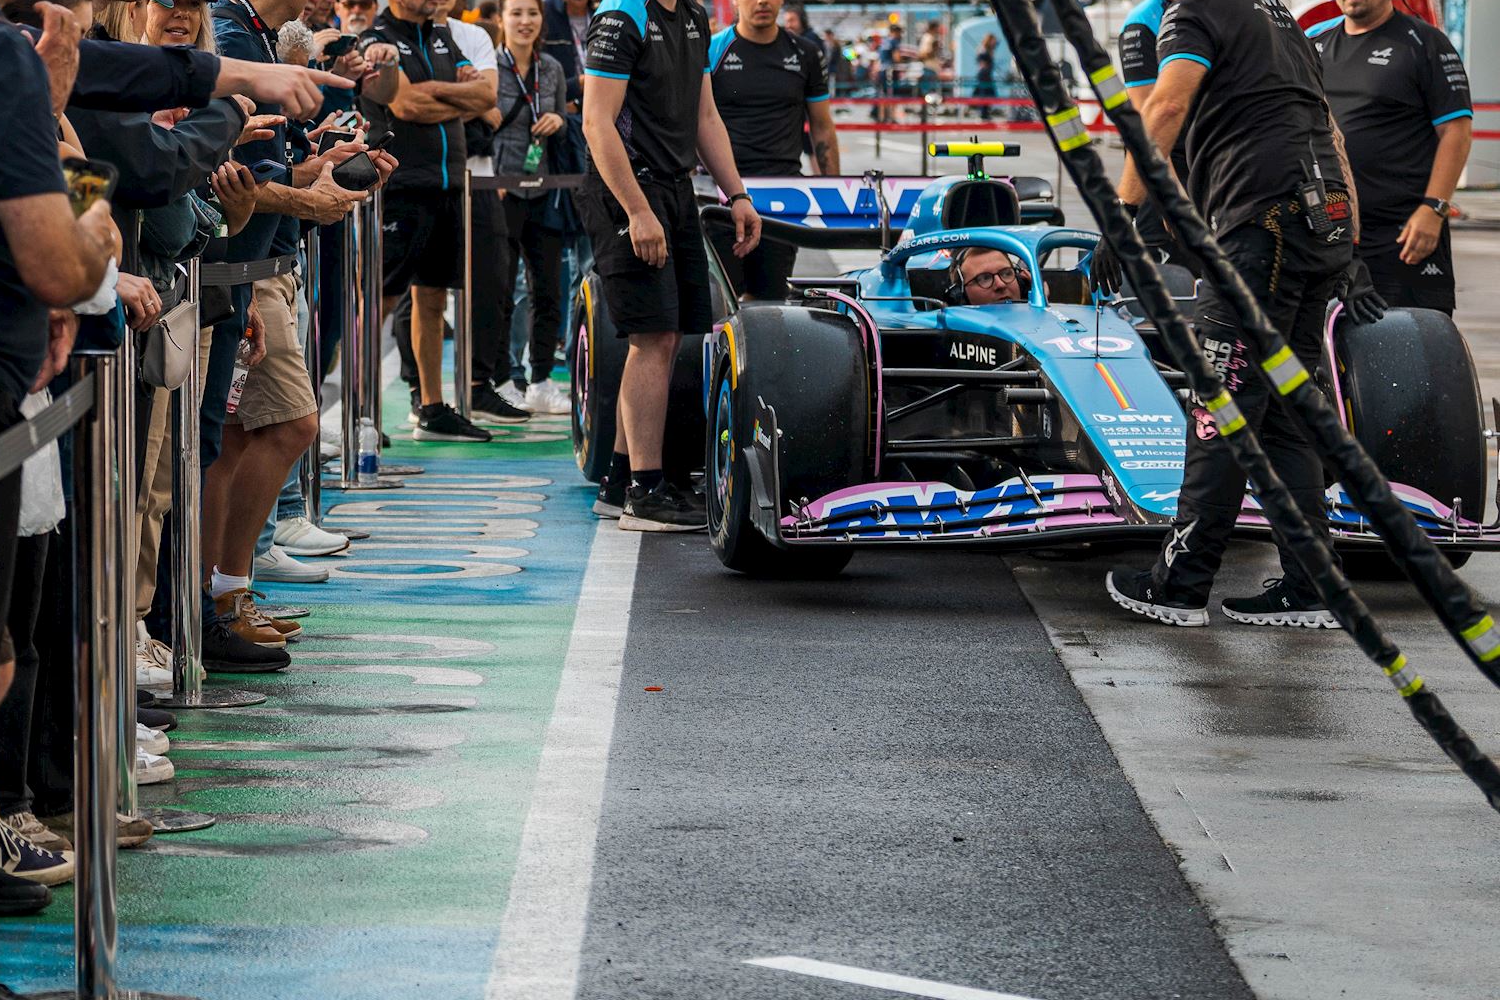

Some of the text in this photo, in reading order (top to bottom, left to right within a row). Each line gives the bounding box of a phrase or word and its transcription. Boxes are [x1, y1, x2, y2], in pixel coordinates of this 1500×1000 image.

[950, 341, 997, 366] ALPINE
[1043, 336, 1135, 353] 10
[1118, 414, 1173, 423] BWT
[825, 480, 1055, 537] BWT
